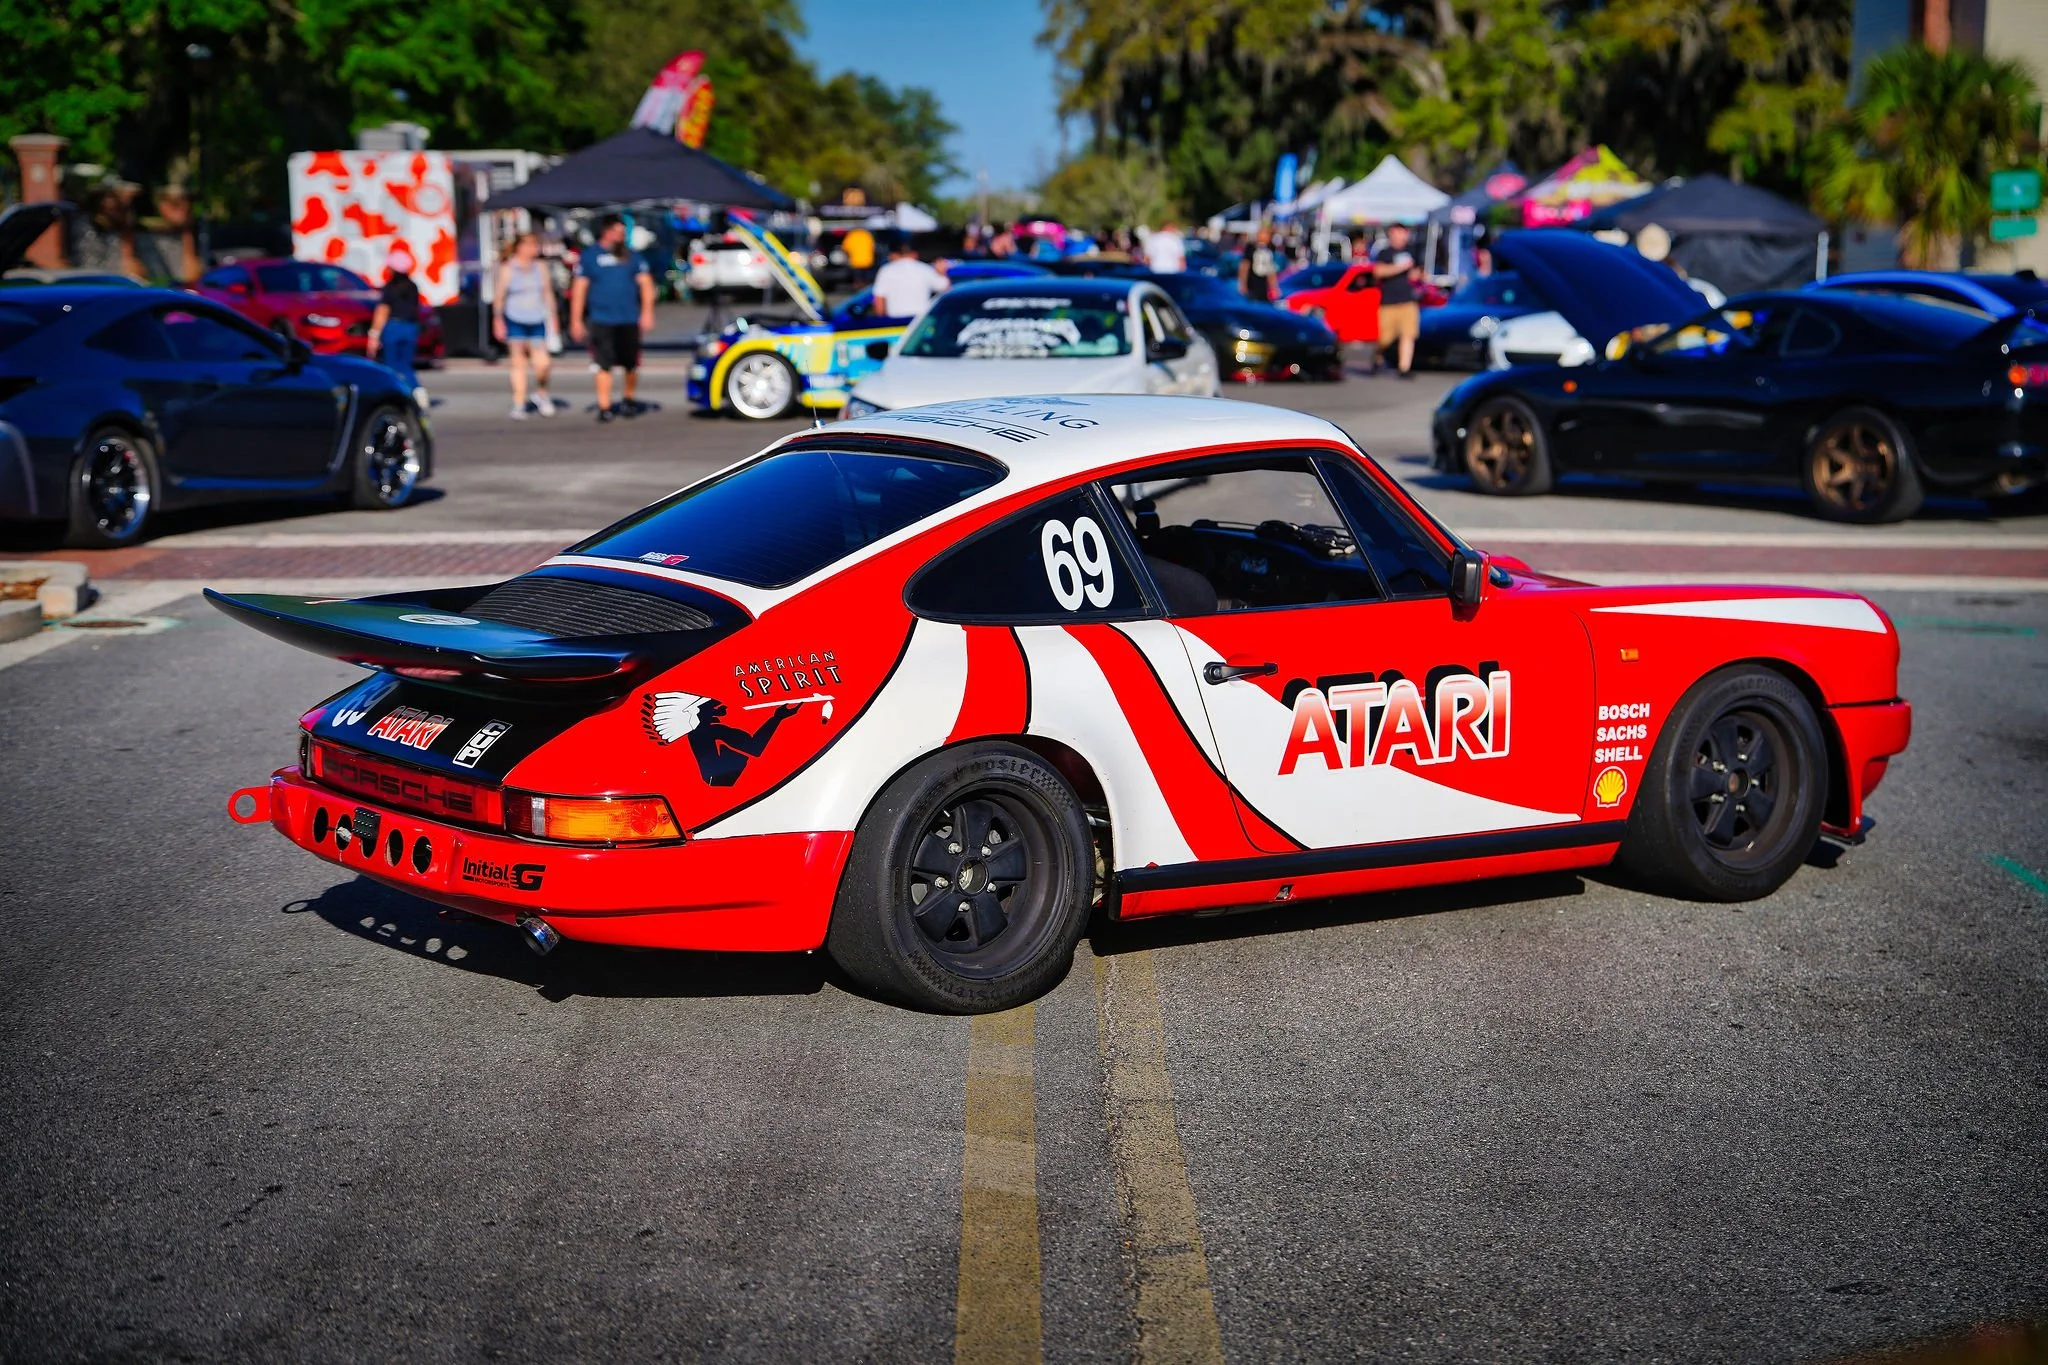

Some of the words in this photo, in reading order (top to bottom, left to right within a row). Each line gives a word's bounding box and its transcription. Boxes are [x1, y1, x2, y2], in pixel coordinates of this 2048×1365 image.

[853, 413, 1037, 443] RSCHE
[926, 403, 1101, 429] ITLING
[1041, 516, 1115, 612] 69
[735, 651, 835, 676] AMERICAN
[740, 665, 842, 698] SPIRIT
[367, 705, 455, 751] ATARI
[1277, 669, 1511, 777] ATARI
[1598, 703, 1651, 721] BOSCH
[455, 720, 508, 764] CUP
[1596, 724, 1647, 742] SACHS
[1594, 745, 1643, 763] SHELL
[325, 757, 473, 813] PORSCHE
[462, 857, 510, 882] Initial
[510, 863, 547, 892] G
